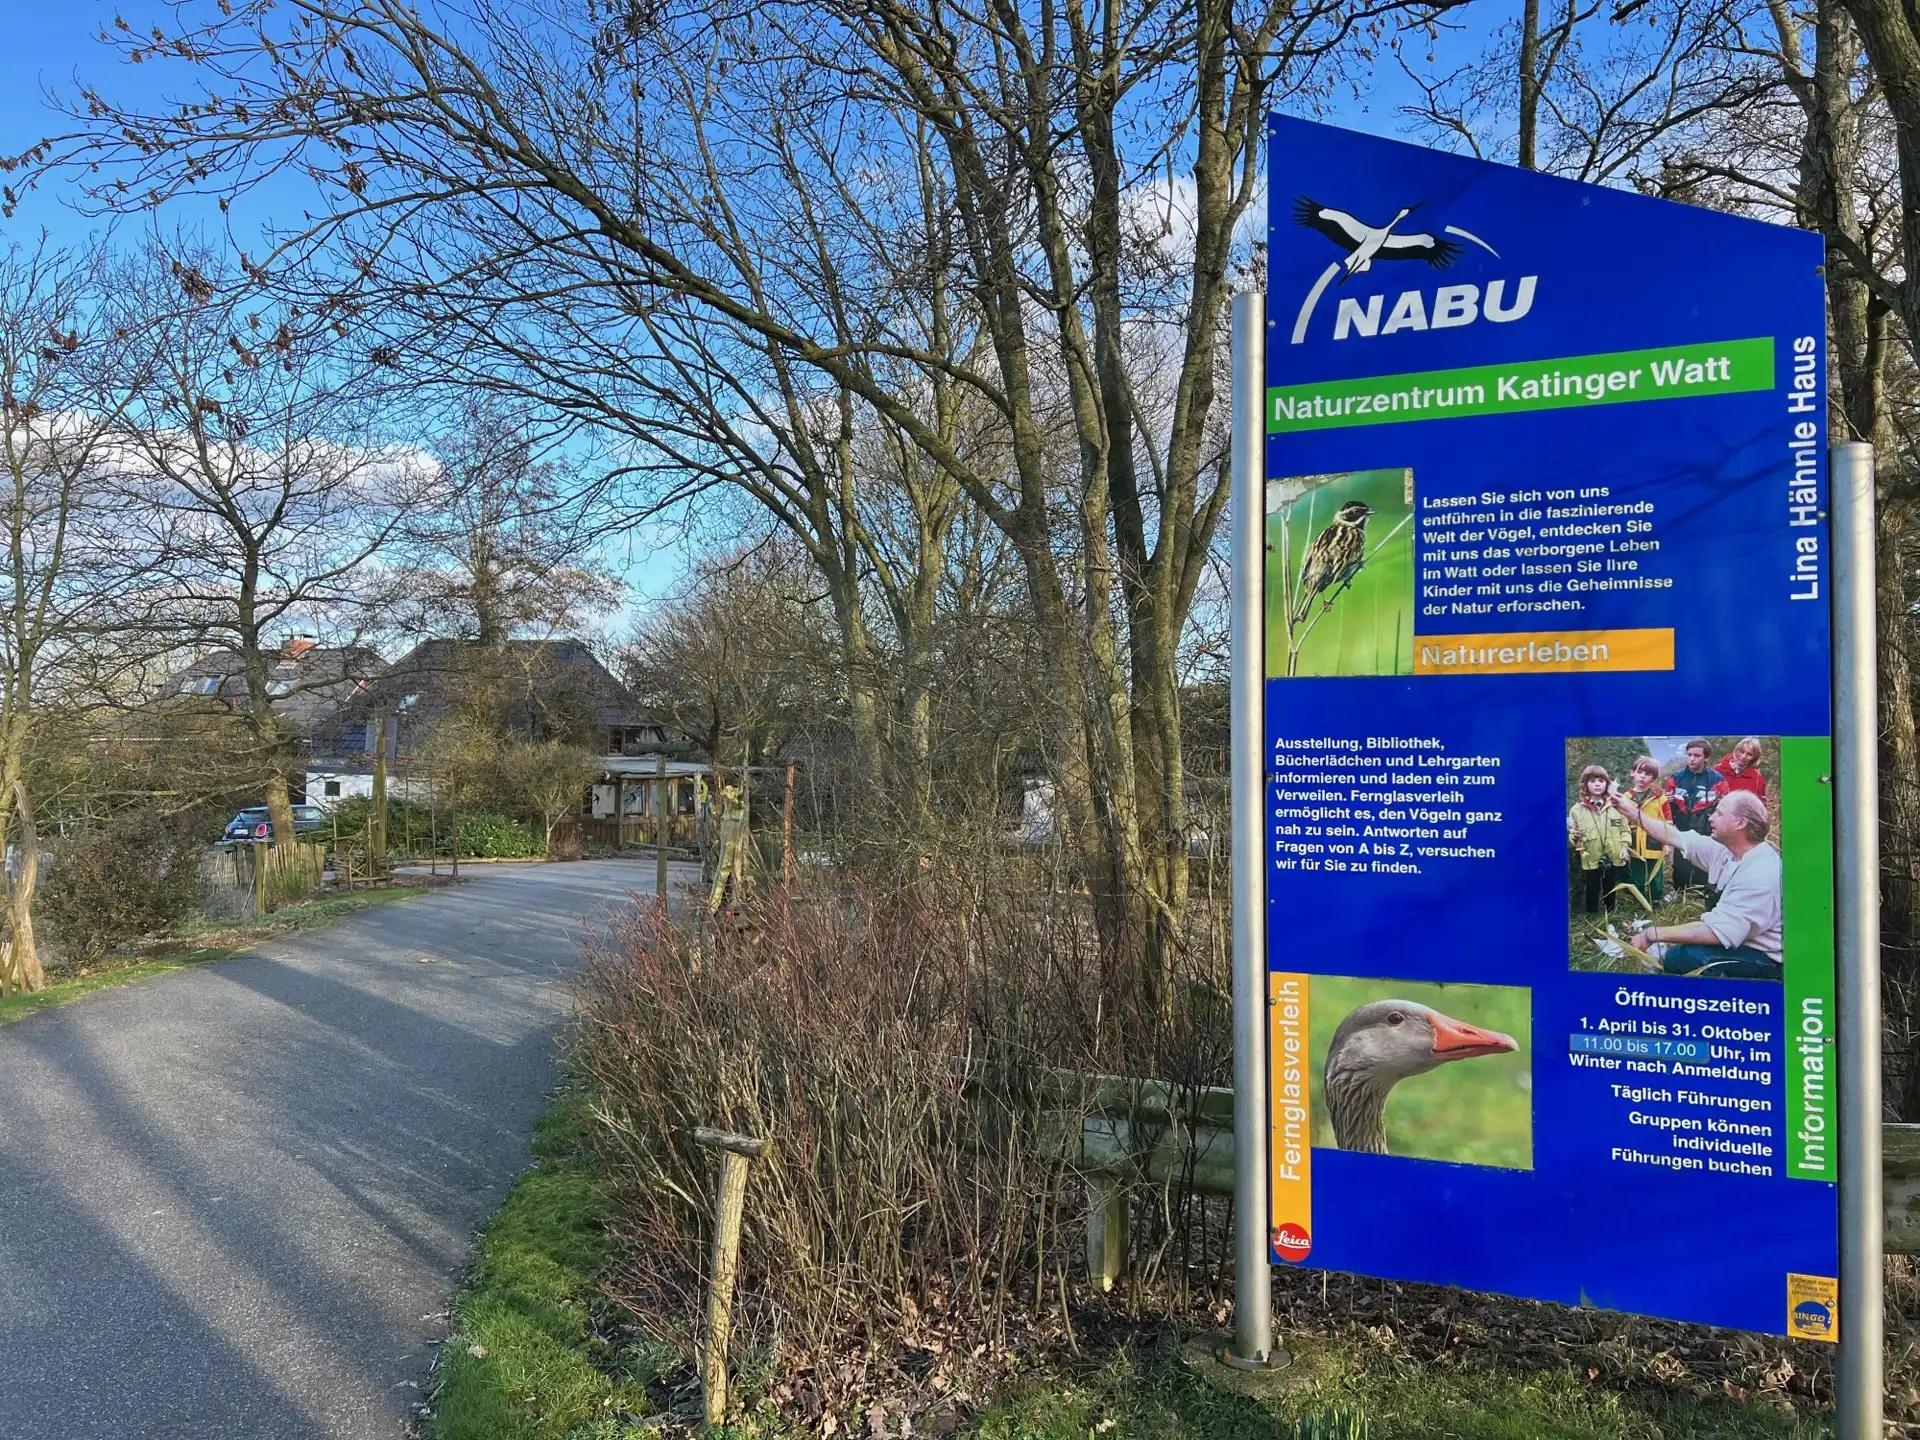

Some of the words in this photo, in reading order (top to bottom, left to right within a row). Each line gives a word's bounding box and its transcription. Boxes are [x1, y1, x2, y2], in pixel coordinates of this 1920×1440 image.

[1332, 275, 1538, 341] NABU
[1788, 336, 1816, 413] Haus
[1274, 383, 1485, 421] Naturzentrum
[1497, 366, 1644, 399] Katinger
[1649, 356, 1731, 387] Watt
[1788, 421, 1817, 526] Hähnle
[1423, 495, 1477, 508] Lassen
[1481, 492, 1505, 504] Sie
[1510, 490, 1541, 503] sich
[1546, 489, 1575, 500] von
[1580, 487, 1609, 497] uns
[1423, 511, 1495, 526] entführen
[1500, 510, 1513, 521] in
[1518, 508, 1542, 520] die
[1547, 501, 1654, 519] faszinierende
[1423, 531, 1455, 544] Welt
[1460, 530, 1484, 542] der
[1488, 528, 1536, 541] Vögel,
[1540, 523, 1621, 537] entdecken
[1626, 521, 1652, 532] Sie
[1423, 550, 1446, 562] mit
[1451, 550, 1478, 560] uns
[1483, 547, 1510, 558] das
[1515, 541, 1604, 558] verborgene
[1610, 539, 1660, 552] Leben
[1423, 568, 1440, 580] im
[1445, 567, 1477, 579] Watt
[1482, 564, 1517, 577] oder
[1521, 563, 1572, 575] lassen
[1577, 561, 1602, 572] Sie
[1607, 559, 1638, 571] Ihre
[1790, 537, 1818, 600] Lina
[1423, 585, 1472, 597] Kinder
[1477, 584, 1501, 595] mit
[1505, 583, 1534, 594] uns
[1539, 580, 1562, 592] die
[1567, 577, 1673, 591] Geheimnisse
[1423, 604, 1447, 615] der
[1452, 602, 1492, 614] Natur
[1497, 599, 1585, 612] erforschen.
[1421, 642, 1609, 665] Naturerleben
[1275, 738, 1363, 751] Ausstellung,
[1367, 737, 1444, 751] Bibliothek,
[1275, 755, 1381, 766] Bücherlädchen
[1386, 756, 1413, 766] und
[1418, 755, 1500, 769] Lehrgarten
[1275, 772, 1355, 783] informieren
[1360, 773, 1387, 784] und
[1392, 773, 1432, 785] laden
[1436, 774, 1458, 785] ein
[1463, 775, 1495, 785] zum
[1276, 790, 1347, 801] Verweilen.
[1351, 790, 1464, 805] Fernglasverleih
[1275, 808, 1350, 821] ermöglicht
[1354, 811, 1375, 821] es,
[1379, 809, 1406, 820] den
[1409, 809, 1461, 823] Vögeln
[1466, 812, 1502, 824] ganz
[1275, 825, 1301, 835] nah
[1305, 827, 1321, 836] zu
[1326, 826, 1359, 837] sein.
[1364, 826, 1439, 838] Antworten
[1443, 828, 1468, 839] auf
[1275, 841, 1324, 857] Fragen
[1328, 844, 1354, 854] von
[1358, 844, 1369, 854] A
[1374, 844, 1395, 855] bis
[1400, 844, 1413, 858] Z,
[1417, 846, 1495, 858] versuchen
[1276, 859, 1297, 870] wir
[1301, 859, 1320, 870] für
[1324, 860, 1347, 871] Sie
[1351, 862, 1367, 872] zu
[1372, 861, 1421, 874] finden.
[1615, 987, 1770, 1015] Öffnungszeiten
[1580, 1017, 1594, 1030] 1.
[1598, 1018, 1637, 1034] April
[1642, 1021, 1666, 1035] bis
[1672, 1024, 1696, 1037] 31.
[1702, 1025, 1771, 1042] Oktober
[1583, 1037, 1622, 1051] 11.00
[1627, 1040, 1648, 1053] bis
[1654, 1042, 1696, 1057] 17.00
[1710, 1046, 1745, 1061] Uhr,
[1750, 1049, 1771, 1062] im
[1279, 980, 1306, 1181] Fernglasverleih
[1569, 1053, 1621, 1070] Winter
[1627, 1060, 1666, 1073] nach
[1672, 1062, 1771, 1085] Anmeldung
[1796, 997, 1825, 1171] Information
[1611, 1084, 1671, 1103] Täglich
[1677, 1090, 1772, 1112] Führungen
[1629, 1112, 1702, 1131] Gruppen
[1707, 1119, 1772, 1136] können
[1673, 1135, 1773, 1157] individuelle
[1611, 1148, 1703, 1170] Führungen
[1708, 1159, 1772, 1176] buchen
[1274, 1230, 1311, 1248] Leica
